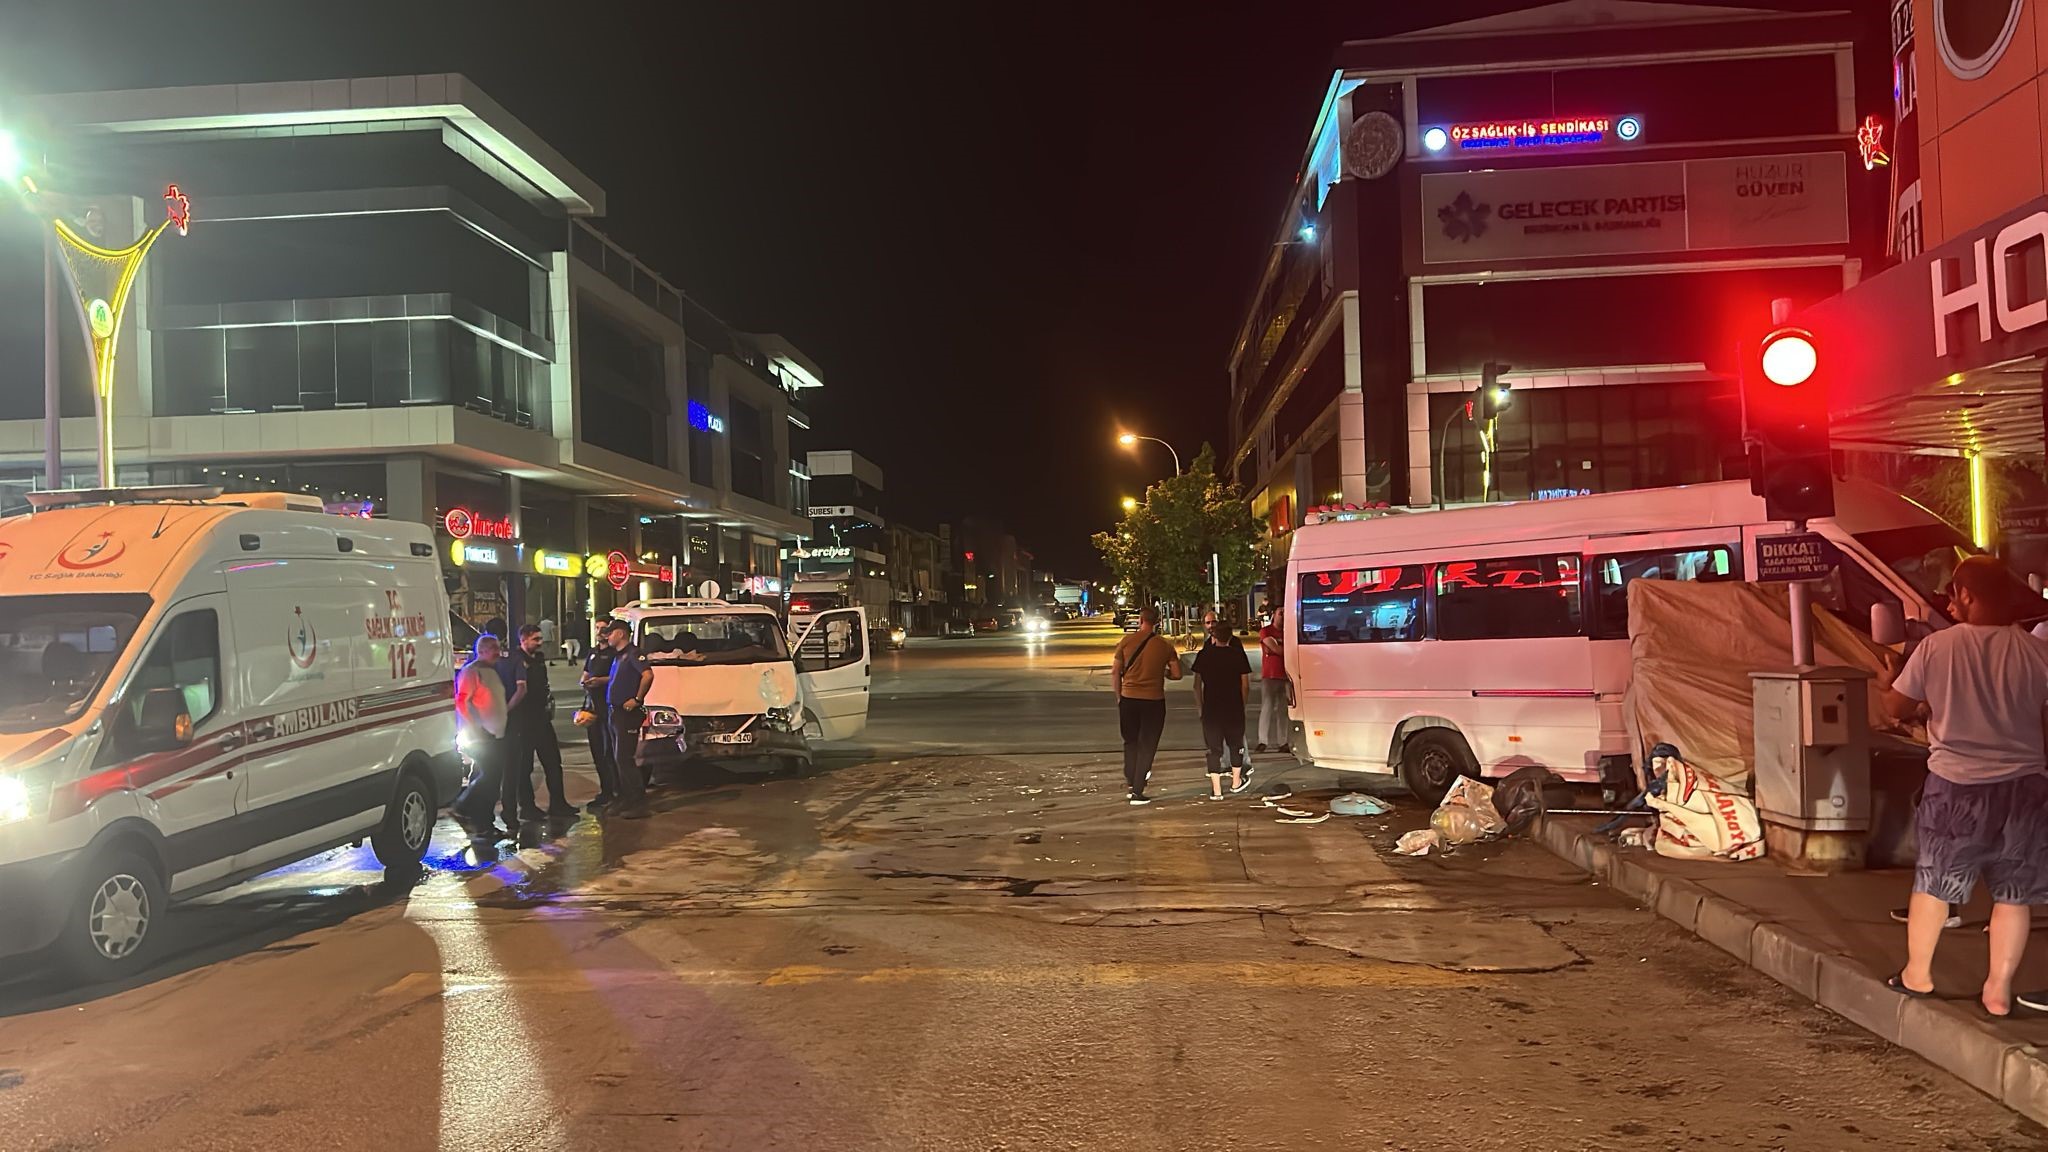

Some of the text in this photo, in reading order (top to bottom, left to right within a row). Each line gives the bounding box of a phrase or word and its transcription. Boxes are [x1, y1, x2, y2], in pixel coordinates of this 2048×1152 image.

[1541, 118, 1609, 135] SENDİKASI
[1736, 180, 1804, 197] GÜVEN
[1497, 198, 1600, 220] GELECEK
[808, 507, 834, 517] ŞUBESİ
[811, 546, 851, 559] erciyes
[388, 642, 417, 680] 112
[273, 698, 357, 738] AMBULANS
